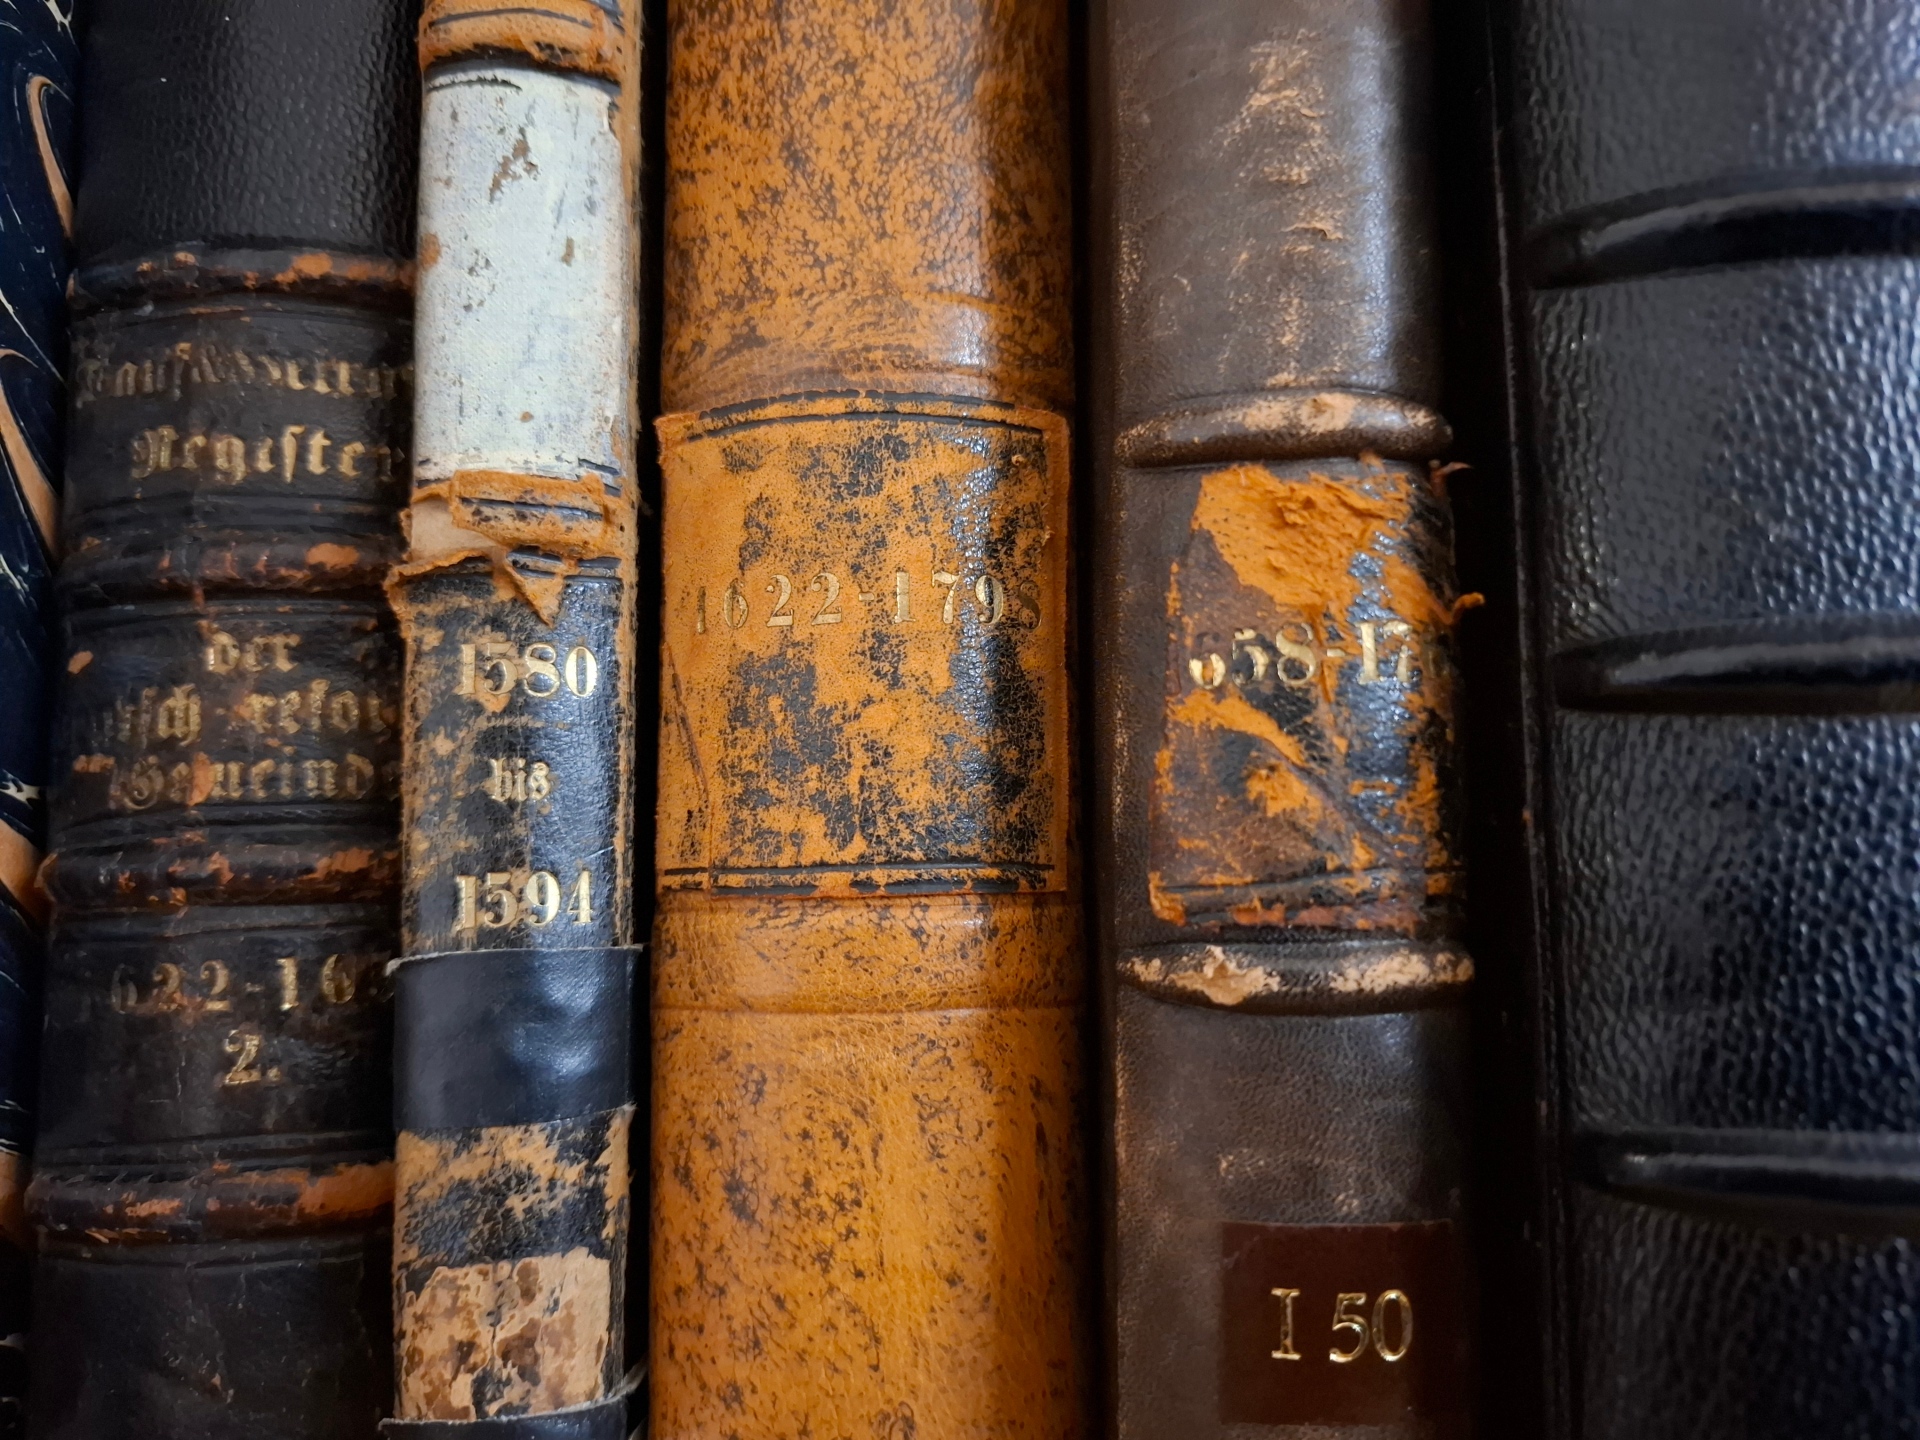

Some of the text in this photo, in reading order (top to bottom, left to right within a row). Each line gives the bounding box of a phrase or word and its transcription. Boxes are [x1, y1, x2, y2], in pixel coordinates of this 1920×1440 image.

[695, 568, 1043, 634] 1622-1798
[453, 641, 598, 697] 1580
[112, 752, 400, 811] Gemeind
[487, 756, 551, 801] bis
[453, 869, 594, 929] 1594
[1271, 1287, 1414, 1364] I 50
